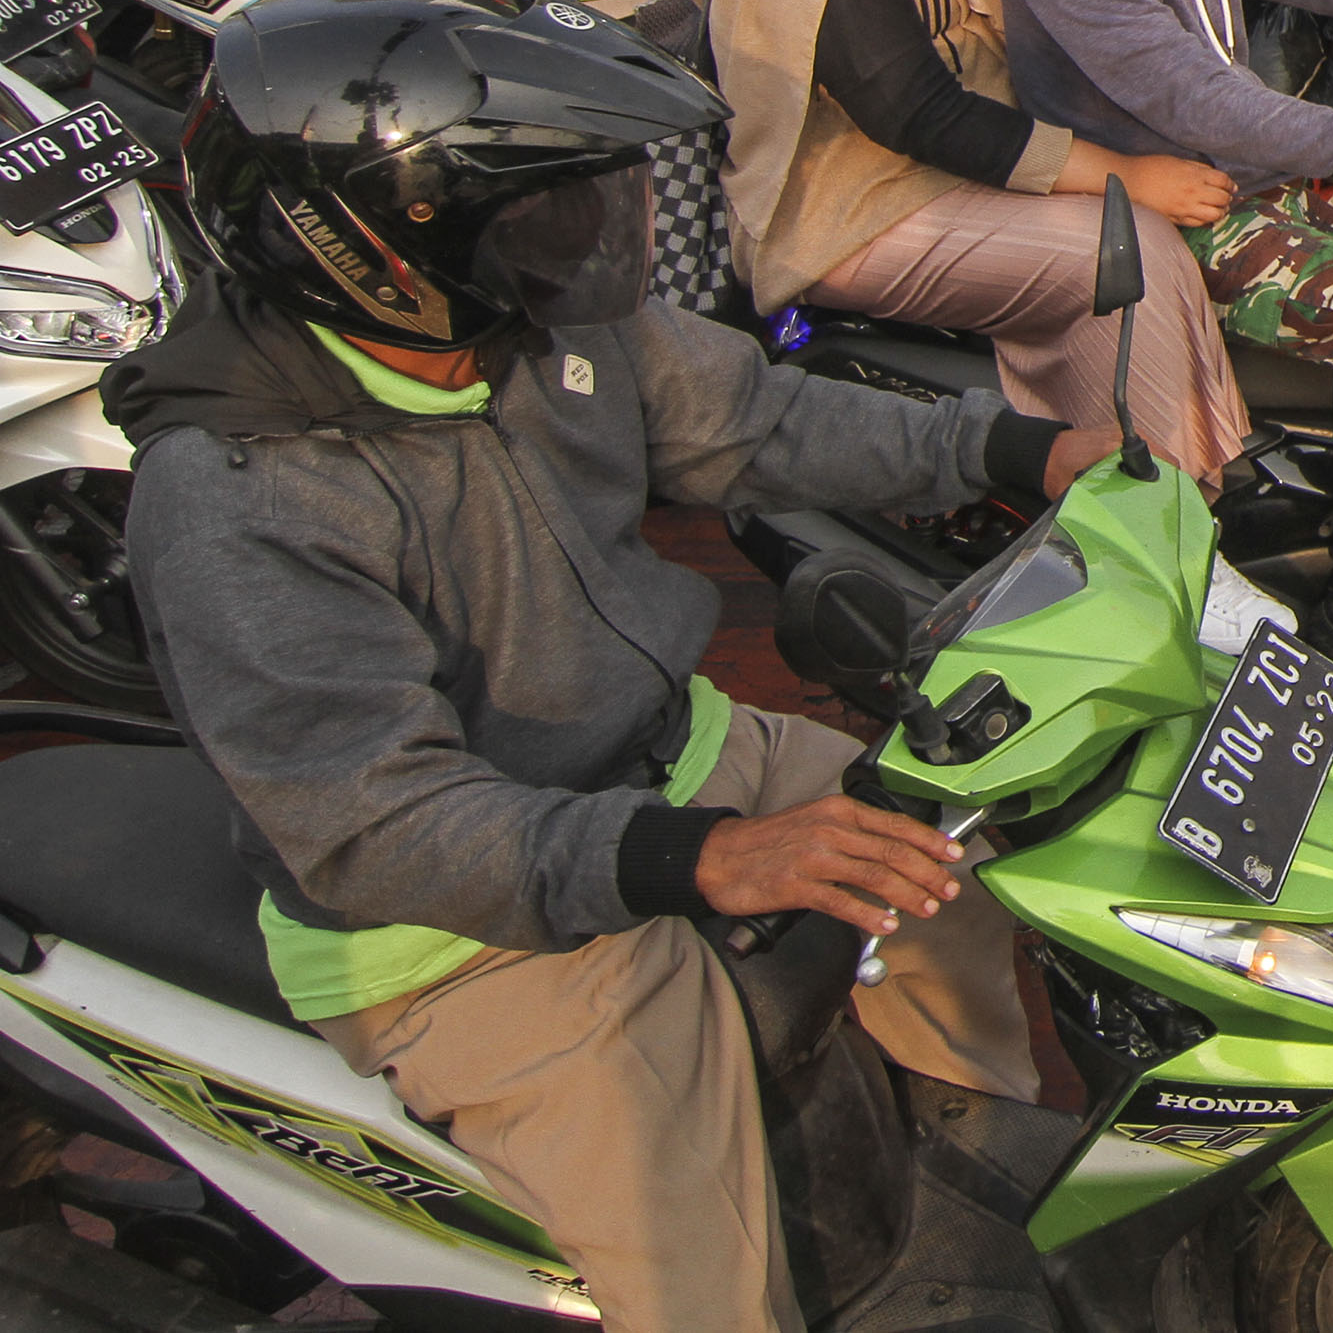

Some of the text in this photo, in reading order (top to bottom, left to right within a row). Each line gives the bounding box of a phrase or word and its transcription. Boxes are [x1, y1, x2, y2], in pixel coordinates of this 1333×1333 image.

[62, 110, 123, 150] ZPZ
[289, 199, 369, 282] YAMAHA
[1173, 816, 1224, 858] B
[1201, 704, 1275, 806] 6704
[1246, 632, 1310, 707] ZCI
[1156, 1092, 1301, 1115] HONDA
